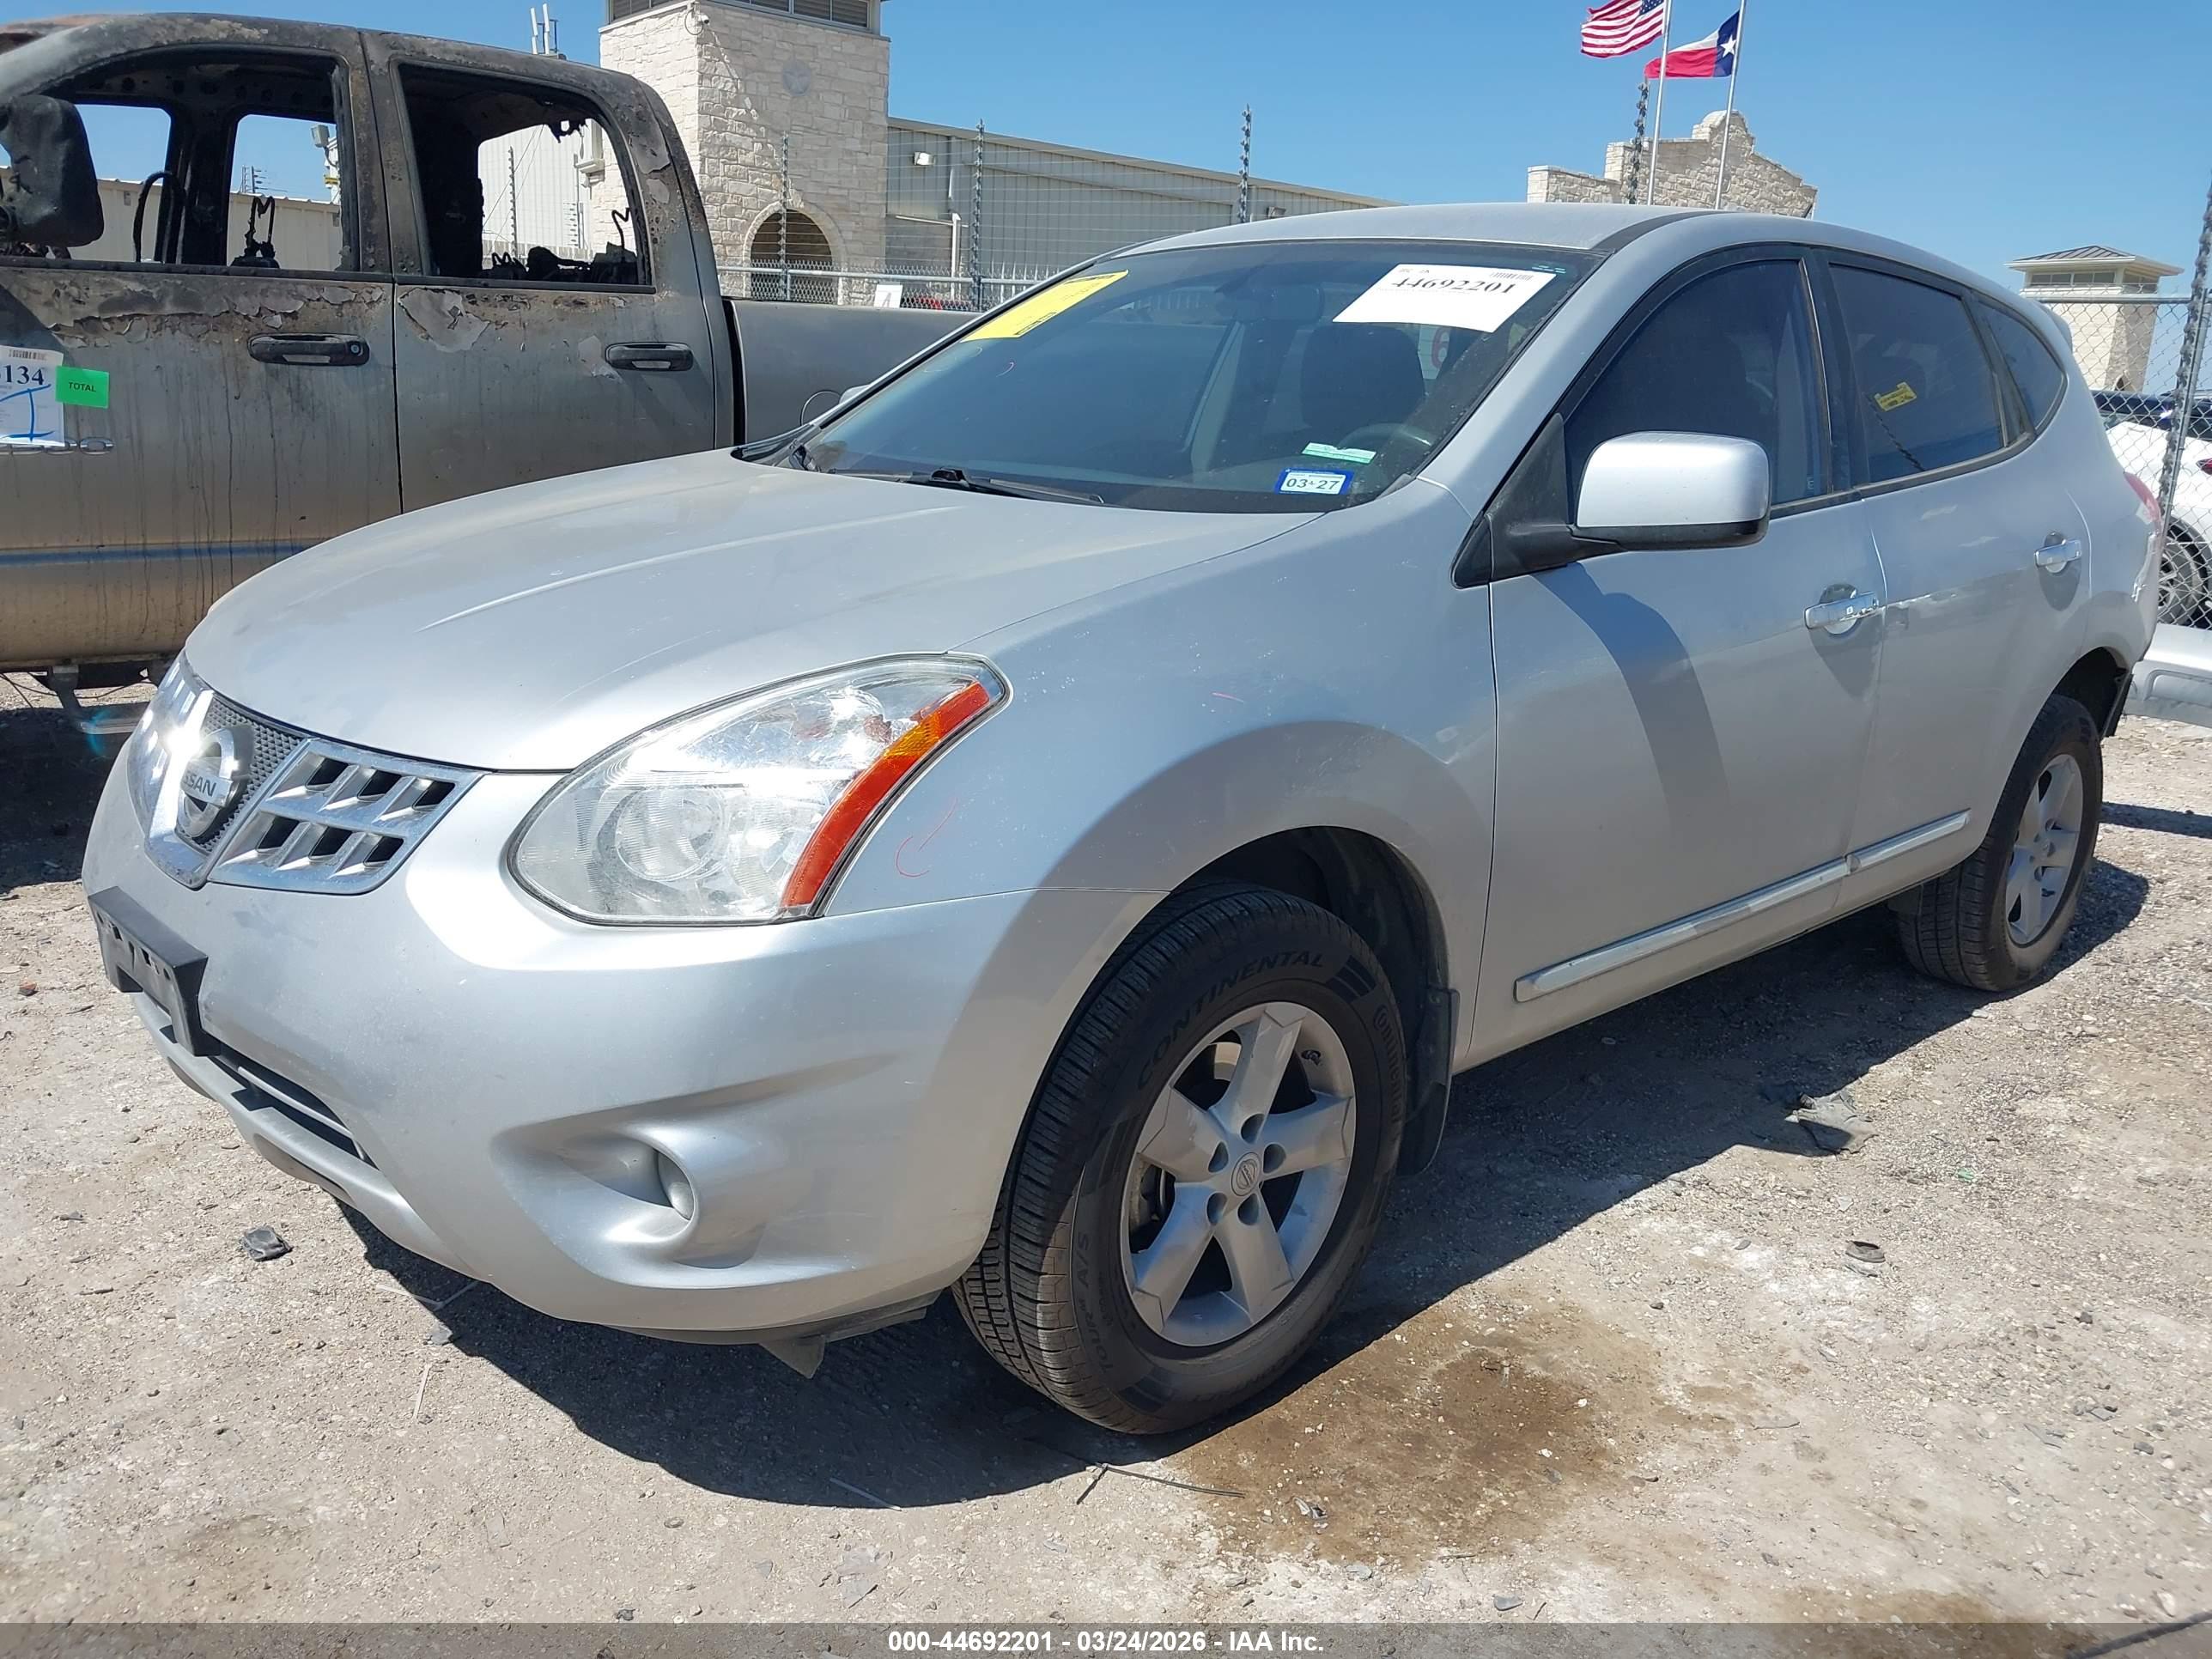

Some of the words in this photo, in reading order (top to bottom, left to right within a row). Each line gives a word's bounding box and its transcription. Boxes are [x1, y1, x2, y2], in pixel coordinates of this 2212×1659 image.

[1391, 277, 1516, 294] 44692201
[0, 364, 45, 386] 134
[68, 381, 97, 392] TOTAL
[1138, 950, 1325, 1089] CONTINENTAL
